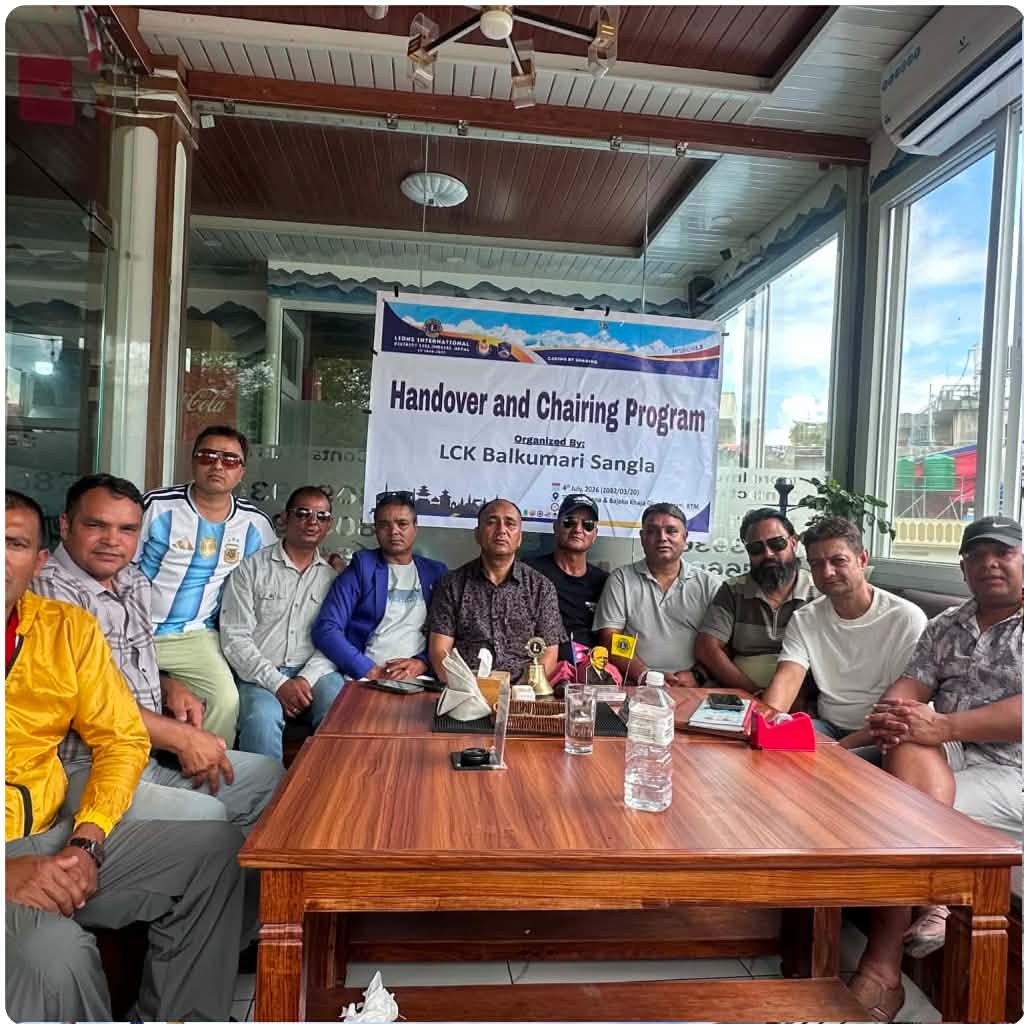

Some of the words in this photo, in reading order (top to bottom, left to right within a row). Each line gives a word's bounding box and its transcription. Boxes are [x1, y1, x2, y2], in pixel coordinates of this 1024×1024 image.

[417, 336, 470, 347] INTERNATIONAL
[390, 379, 488, 415] Handover
[493, 389, 531, 418] and
[536, 391, 619, 433] Chairing
[625, 398, 706, 437] Program
[514, 434, 566, 447] Organized
[569, 439, 585, 449] By:
[439, 444, 476, 461] LCK
[482, 447, 584, 468] Balkumari
[590, 454, 655, 475] Sangla
